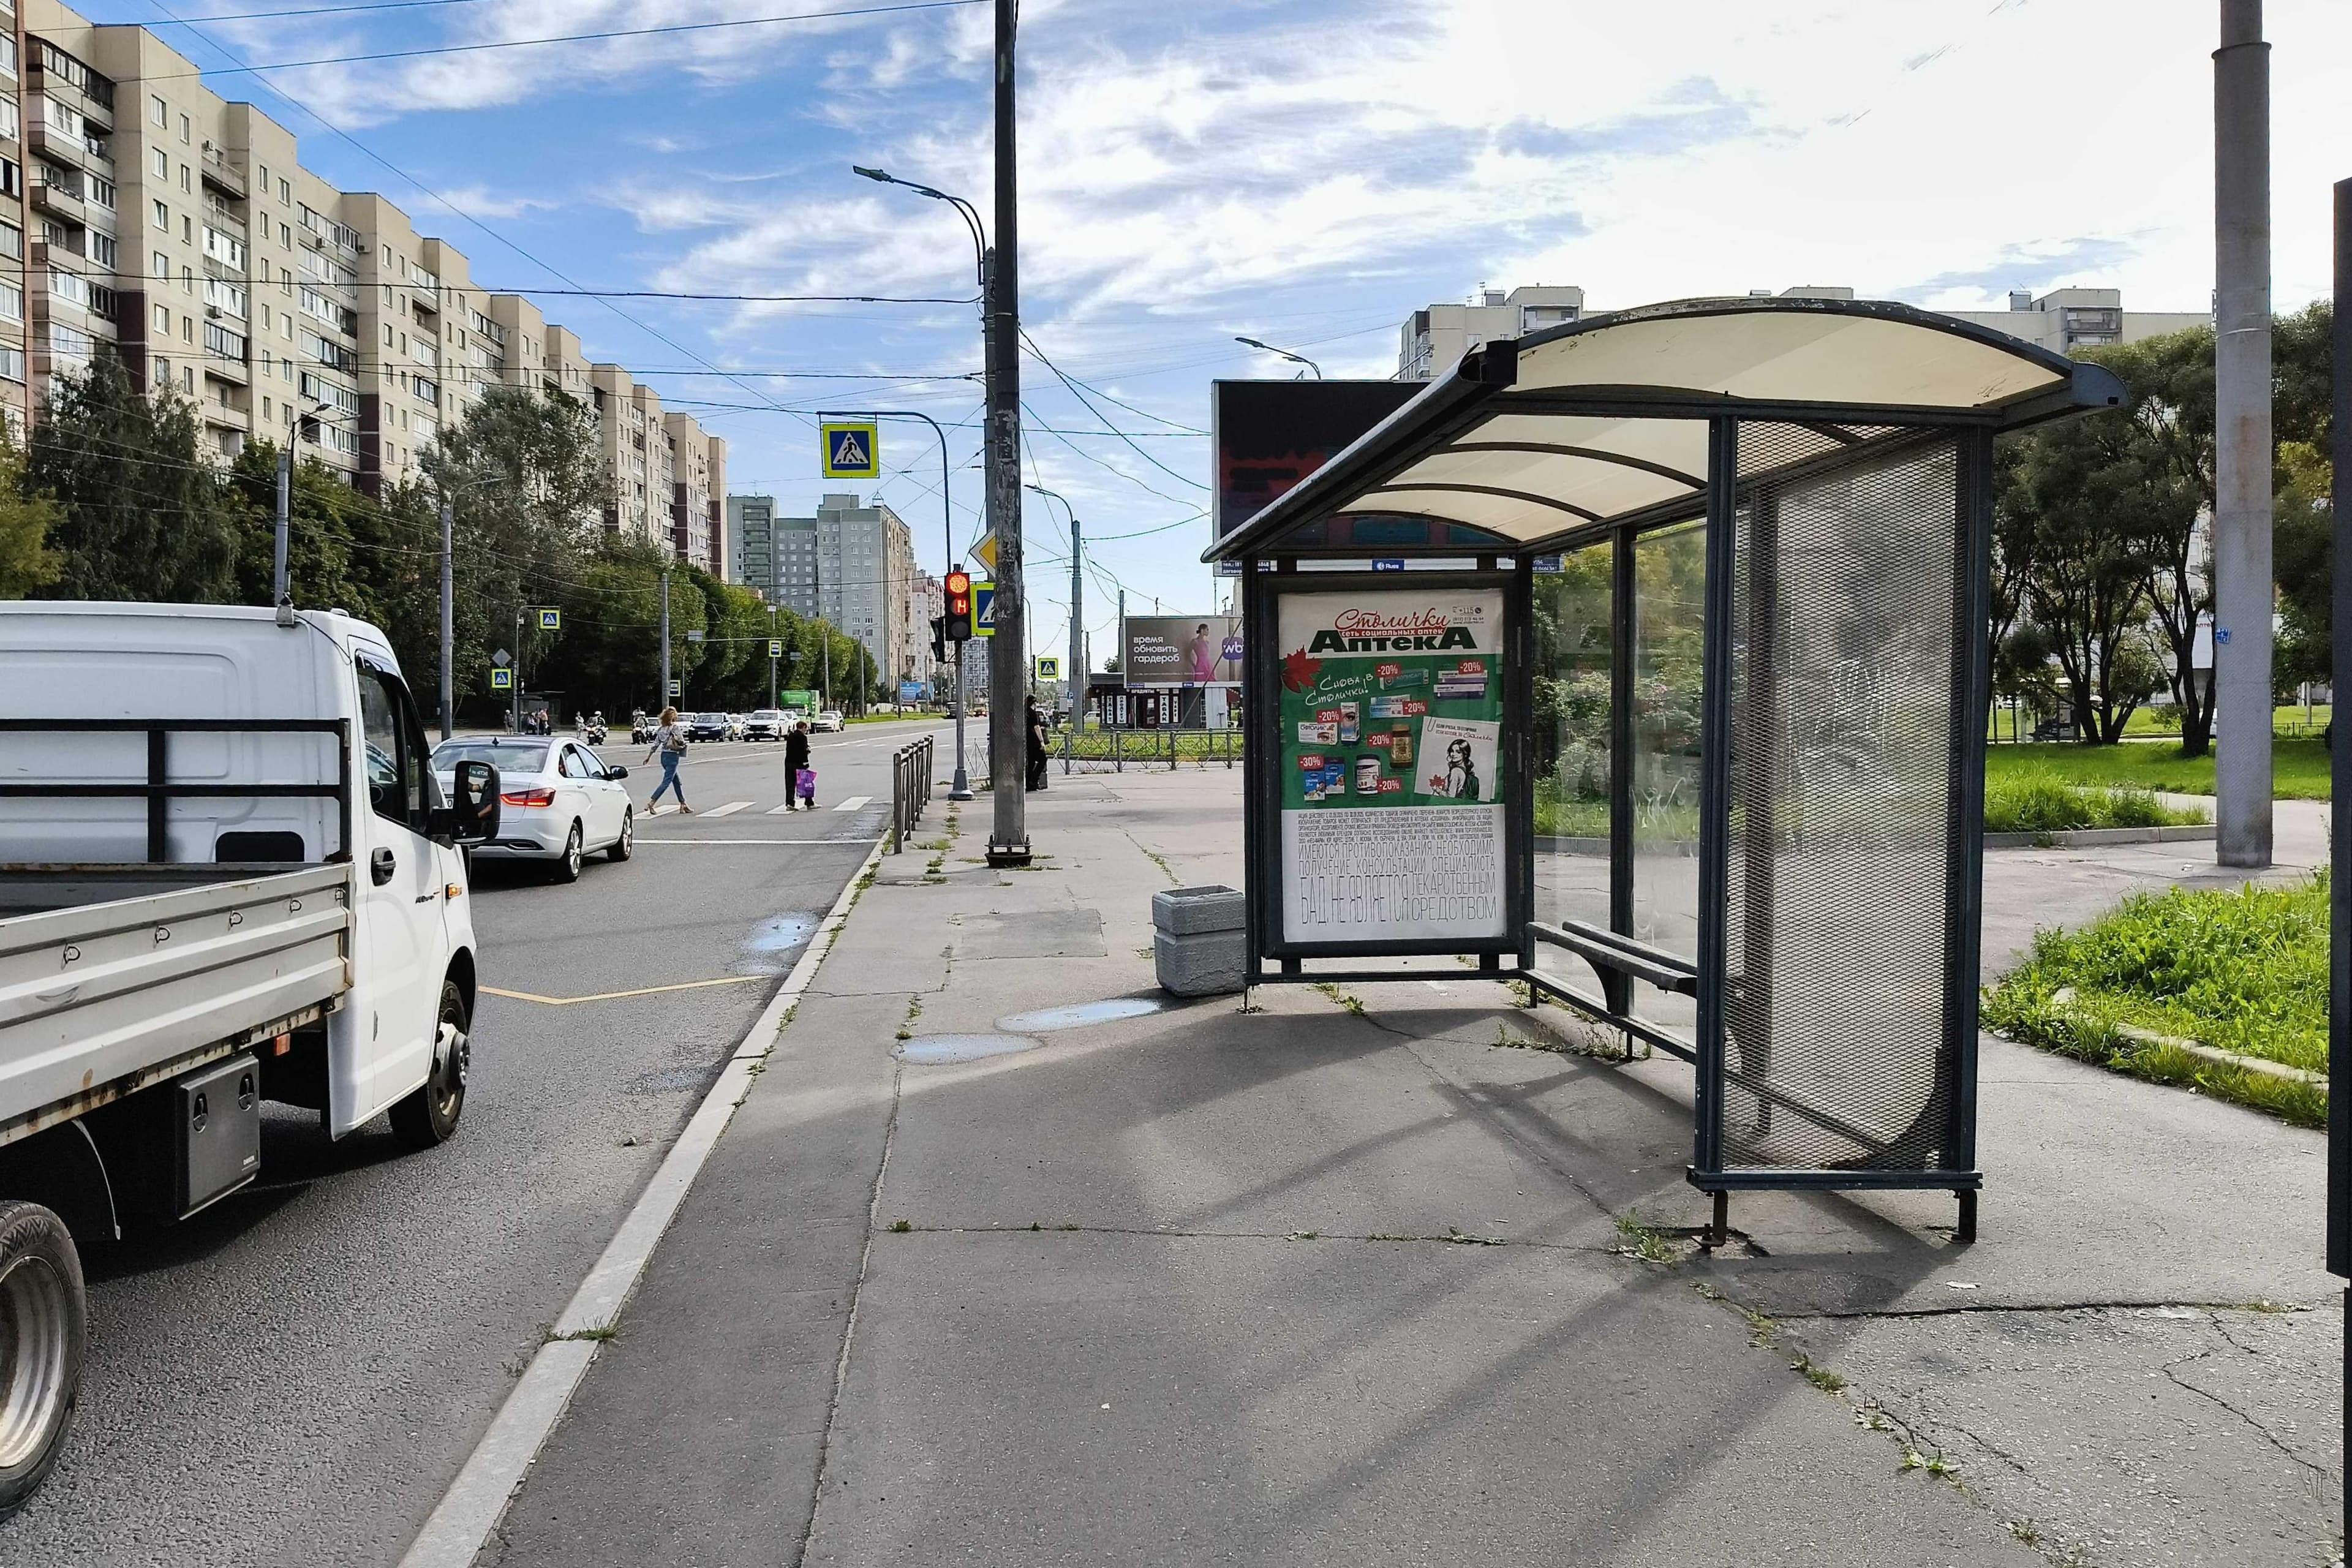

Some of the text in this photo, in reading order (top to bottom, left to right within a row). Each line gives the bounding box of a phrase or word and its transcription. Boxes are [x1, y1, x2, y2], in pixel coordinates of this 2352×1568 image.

[1335, 608, 1451, 630] Столички
[1361, 629, 1415, 639] социальных
[1133, 636, 1164, 645] время
[1133, 644, 1178, 654] обновить
[1134, 654, 1180, 664] гардероб
[1378, 665, 1398, 676] -20%
[1460, 662, 1480, 672] -20%
[1404, 702, 1425, 713] -20%
[1318, 710, 1340, 722] -20%
[1369, 734, 1390, 745] -20%
[1300, 756, 1321, 767] -30%
[1379, 780, 1400, 790] -20%
[1298, 839, 1494, 859] ИМЕЮТСЯ ПРОТИВОПОКАЗАНИЯ. НЕОБХОДИМО
[1298, 856, 1495, 876] ПОЛУЧЕНИЕ КОНСУЛЬТАЦИИ СПЕЦИАЛИСТА
[1411, 872, 1495, 895] ЛЕКАРСТВЕННЫМ
[1331, 875, 1346, 923] НЕ
[1348, 874, 1408, 923] ЯВЛЯЕТСЯ
[1411, 895, 1496, 922] СРЕДСТВОМ
